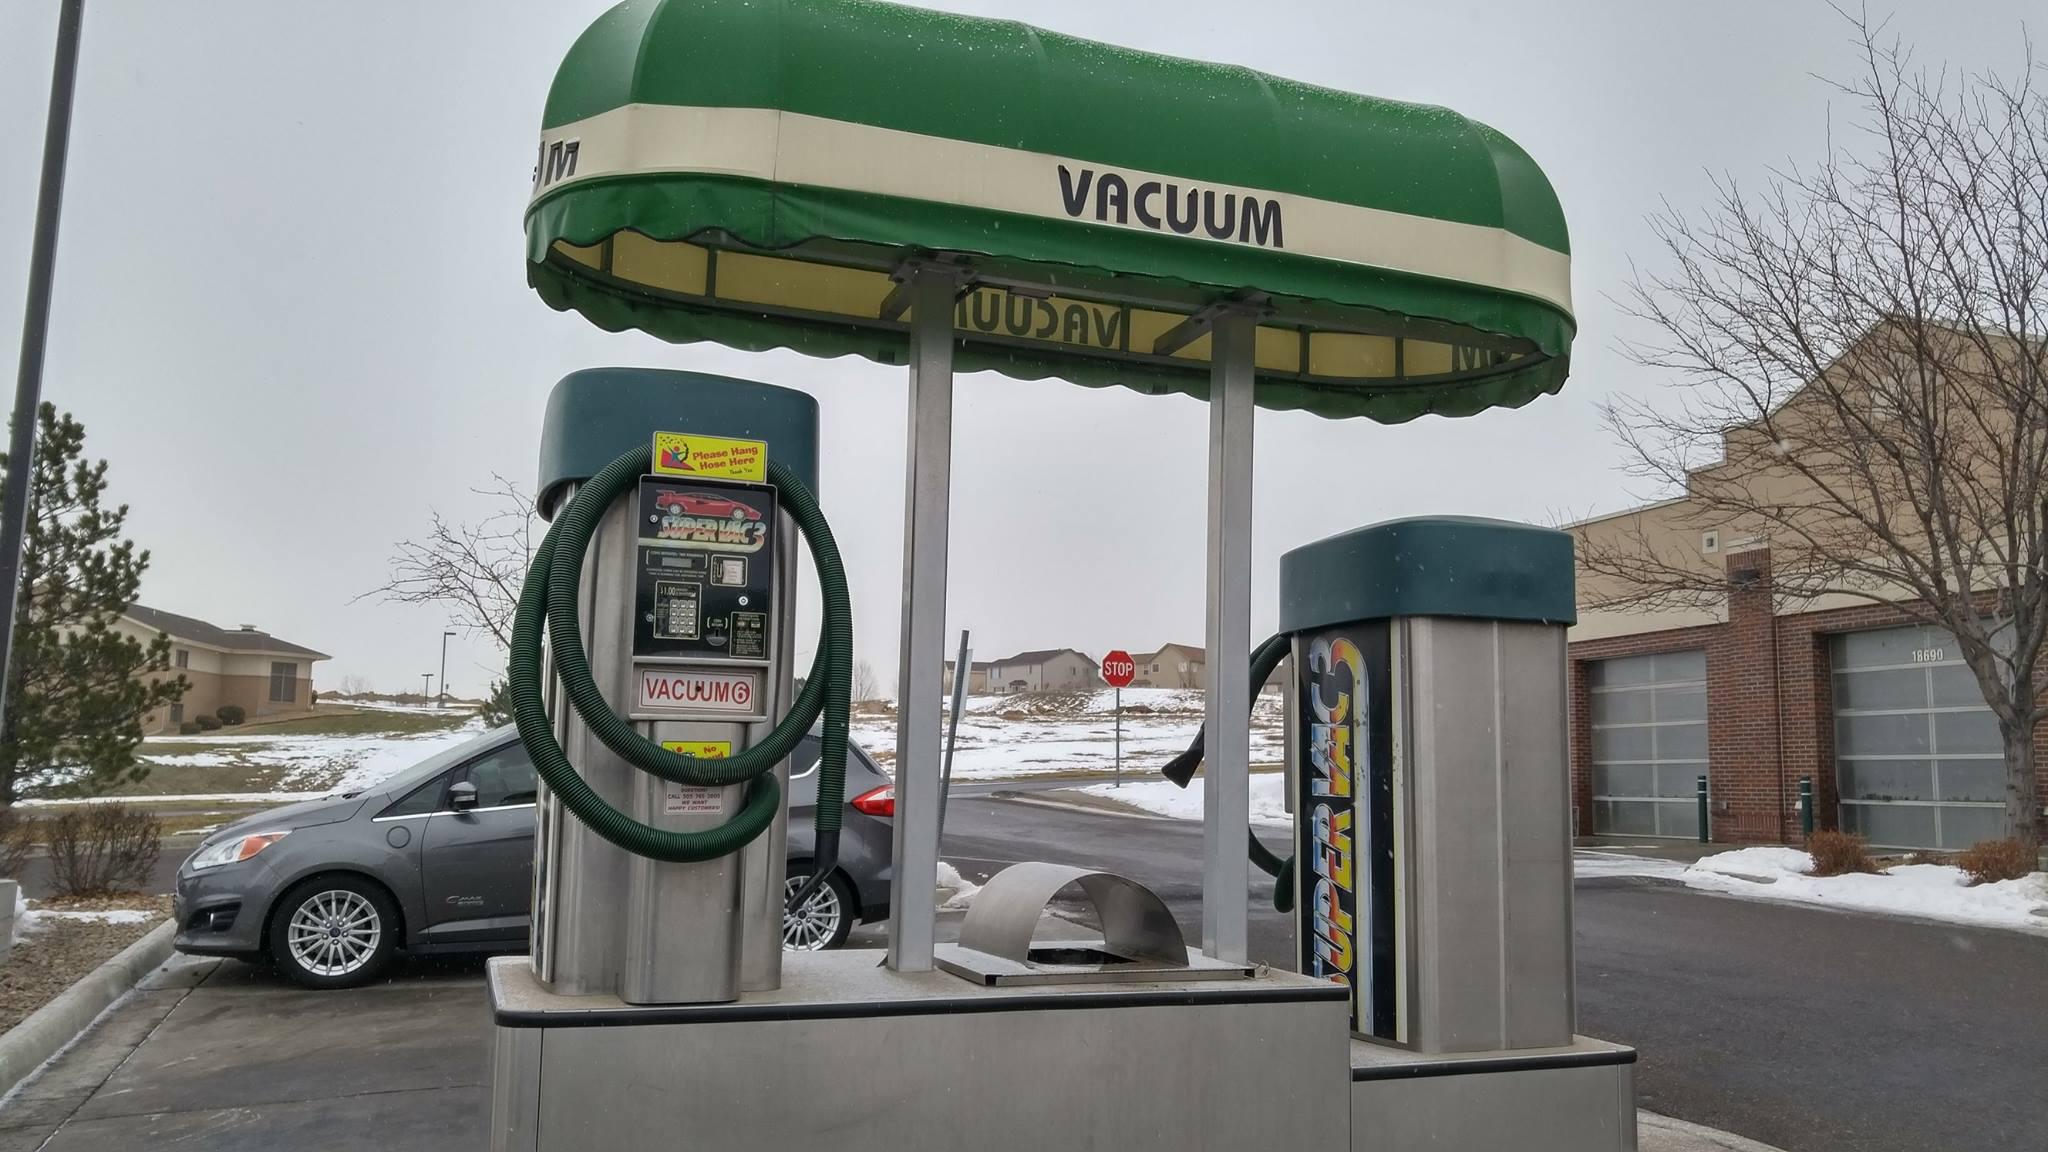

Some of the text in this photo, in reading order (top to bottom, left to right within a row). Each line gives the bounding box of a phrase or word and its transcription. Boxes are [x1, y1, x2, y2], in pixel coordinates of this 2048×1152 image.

[1057, 164, 1284, 248] VACUUM
[692, 446, 758, 461] Please Hang
[699, 456, 755, 471] Hose Here
[657, 515, 718, 542] SUPER
[1911, 648, 1944, 663] 18690
[1105, 661, 1133, 677] STOP
[645, 678, 730, 702] VACUUM
